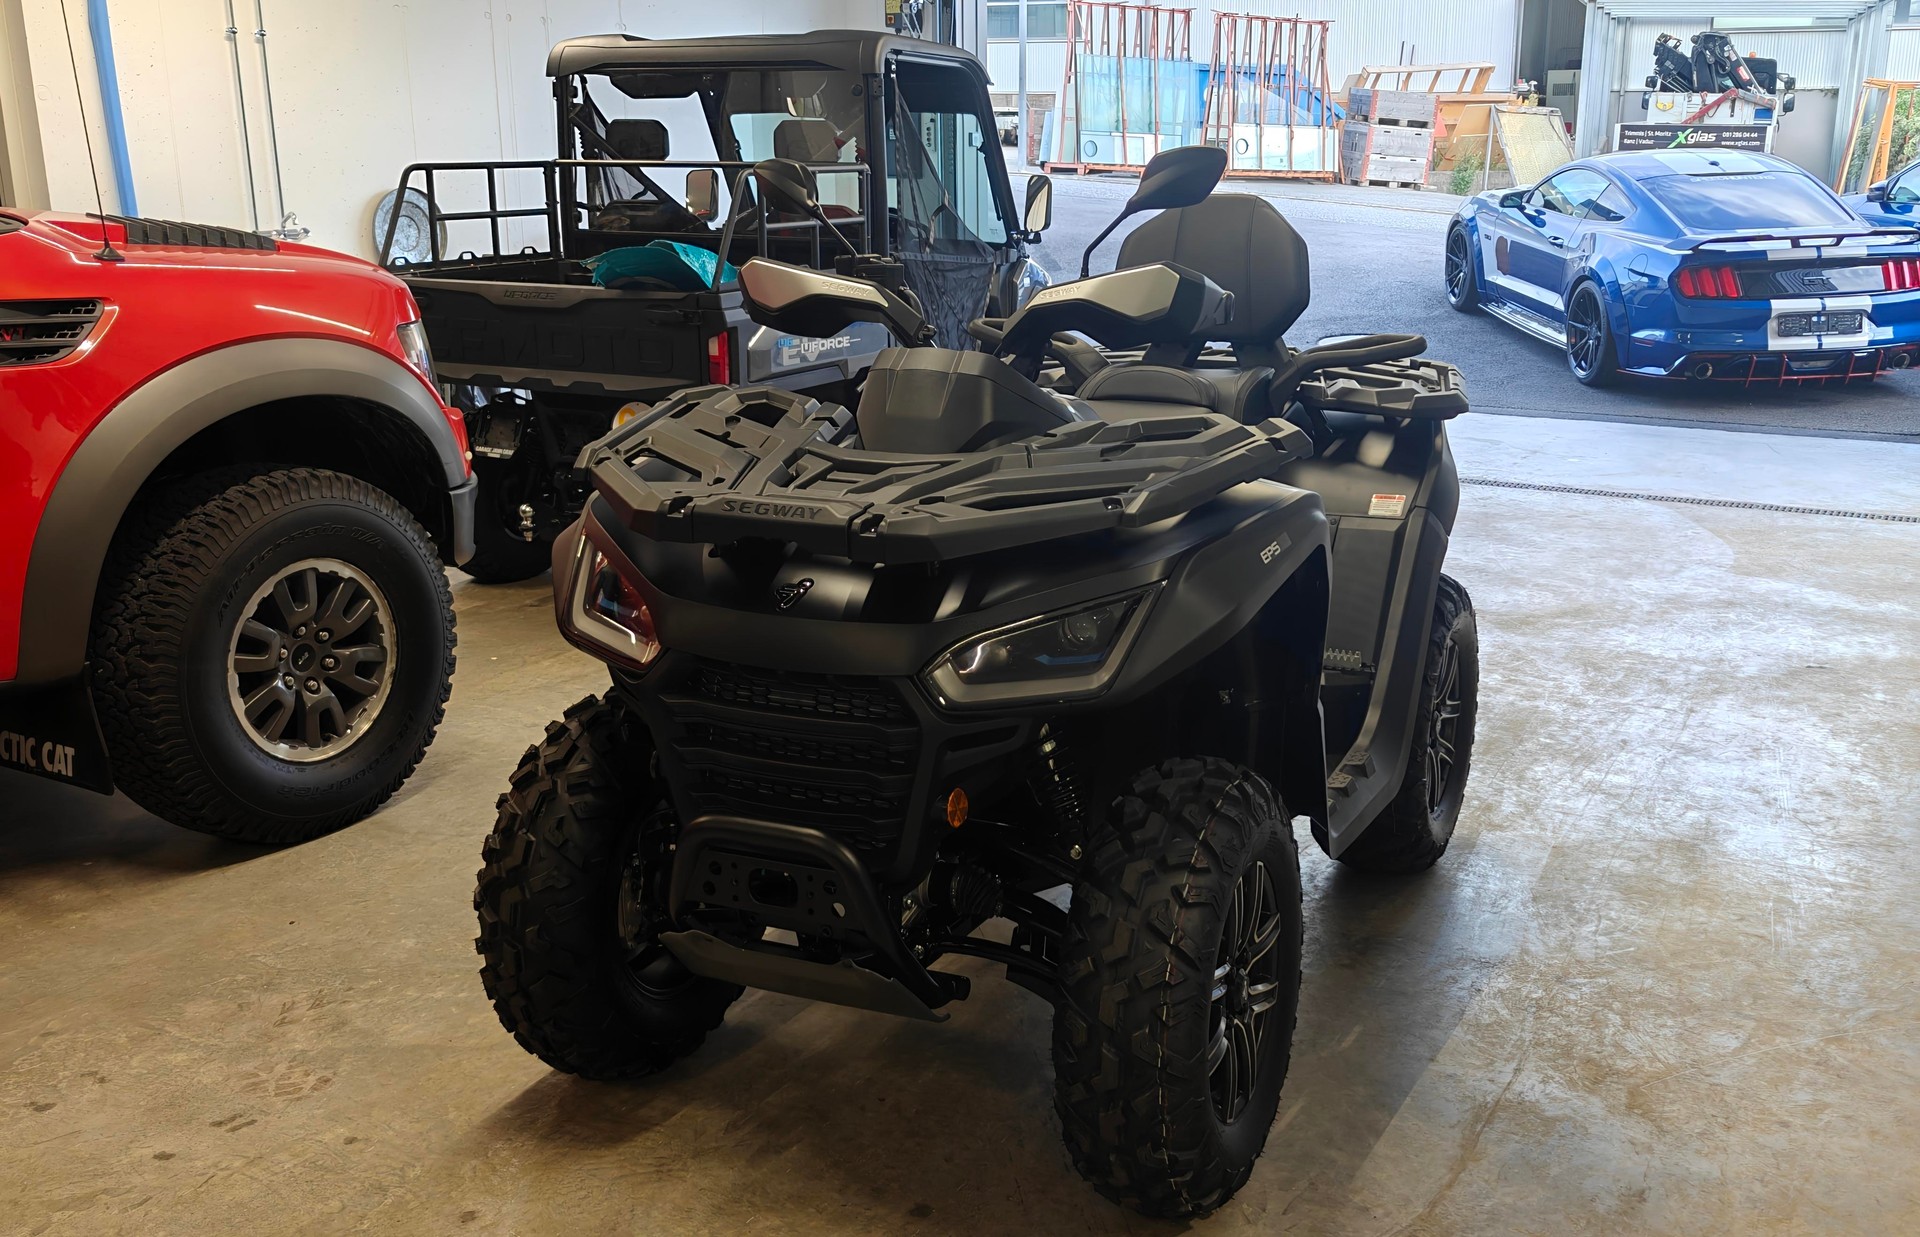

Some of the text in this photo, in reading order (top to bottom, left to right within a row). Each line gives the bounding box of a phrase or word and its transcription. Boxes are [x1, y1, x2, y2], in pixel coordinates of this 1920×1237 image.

[1667, 128, 1717, 149] Xglas
[821, 281, 870, 297] SEGWAY
[1040, 286, 1081, 299] SEGWAY
[721, 500, 822, 520] SEGWAY
[1260, 541, 1281, 564] EPS
[42, 741, 75, 777] CAT
